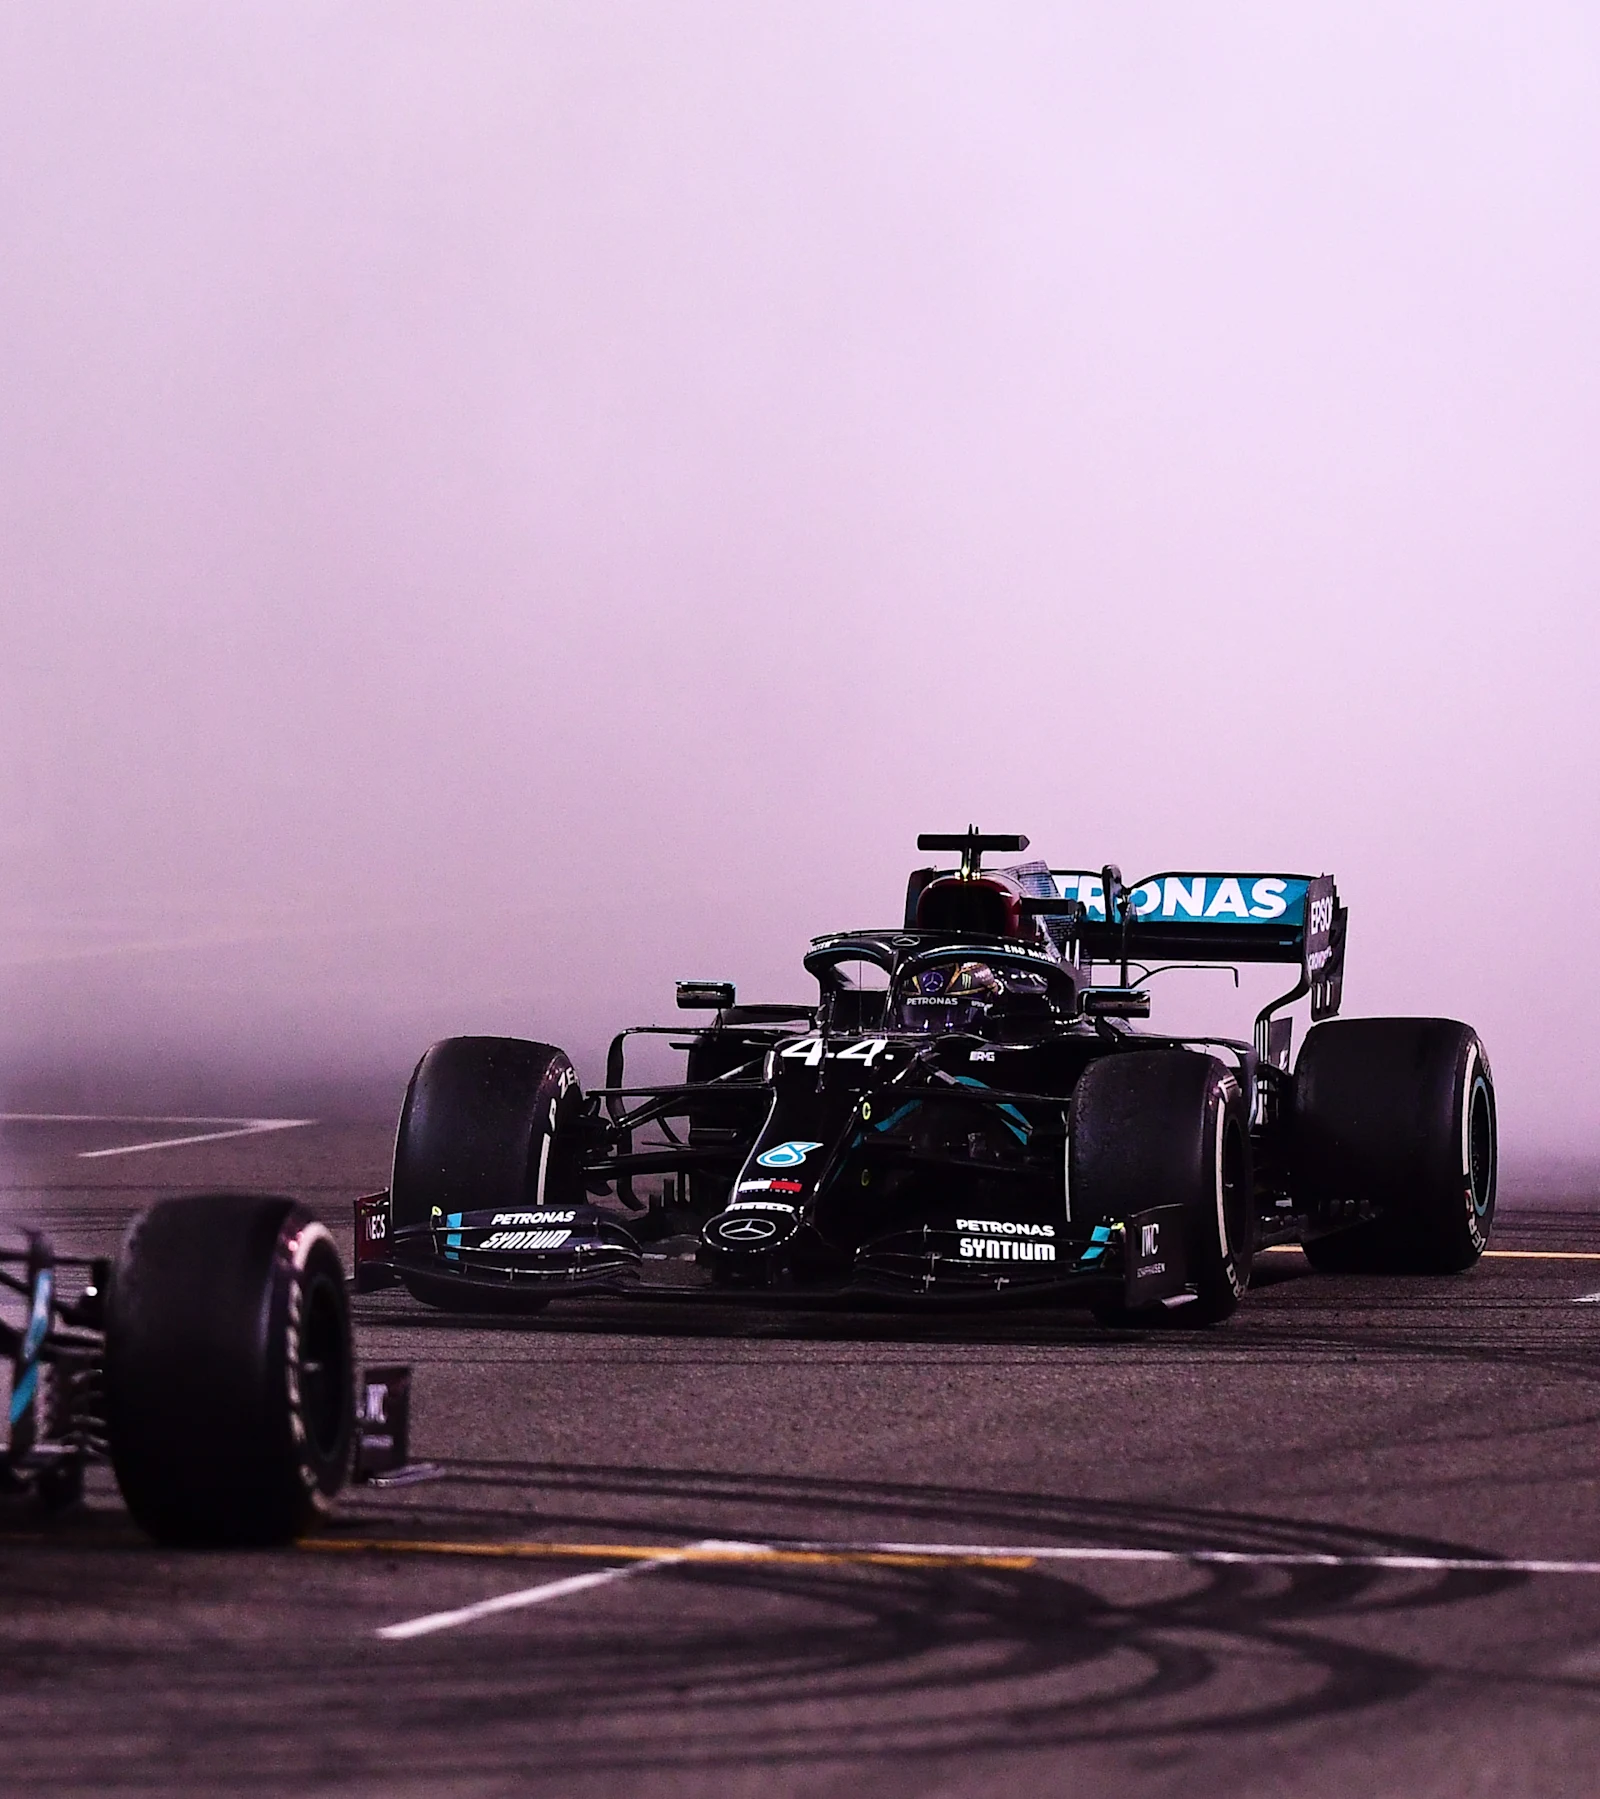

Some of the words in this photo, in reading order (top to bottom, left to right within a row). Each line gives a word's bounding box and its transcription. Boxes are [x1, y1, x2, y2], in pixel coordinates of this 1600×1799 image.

[907, 997, 958, 1006] PETRONAS
[491, 1211, 576, 1225] PETRONAS
[956, 1219, 1055, 1237] PETRONAS
[480, 1229, 572, 1249] SYNTIUM
[1141, 1223, 1160, 1257] IWC
[960, 1238, 1056, 1261] SYNTIUM
